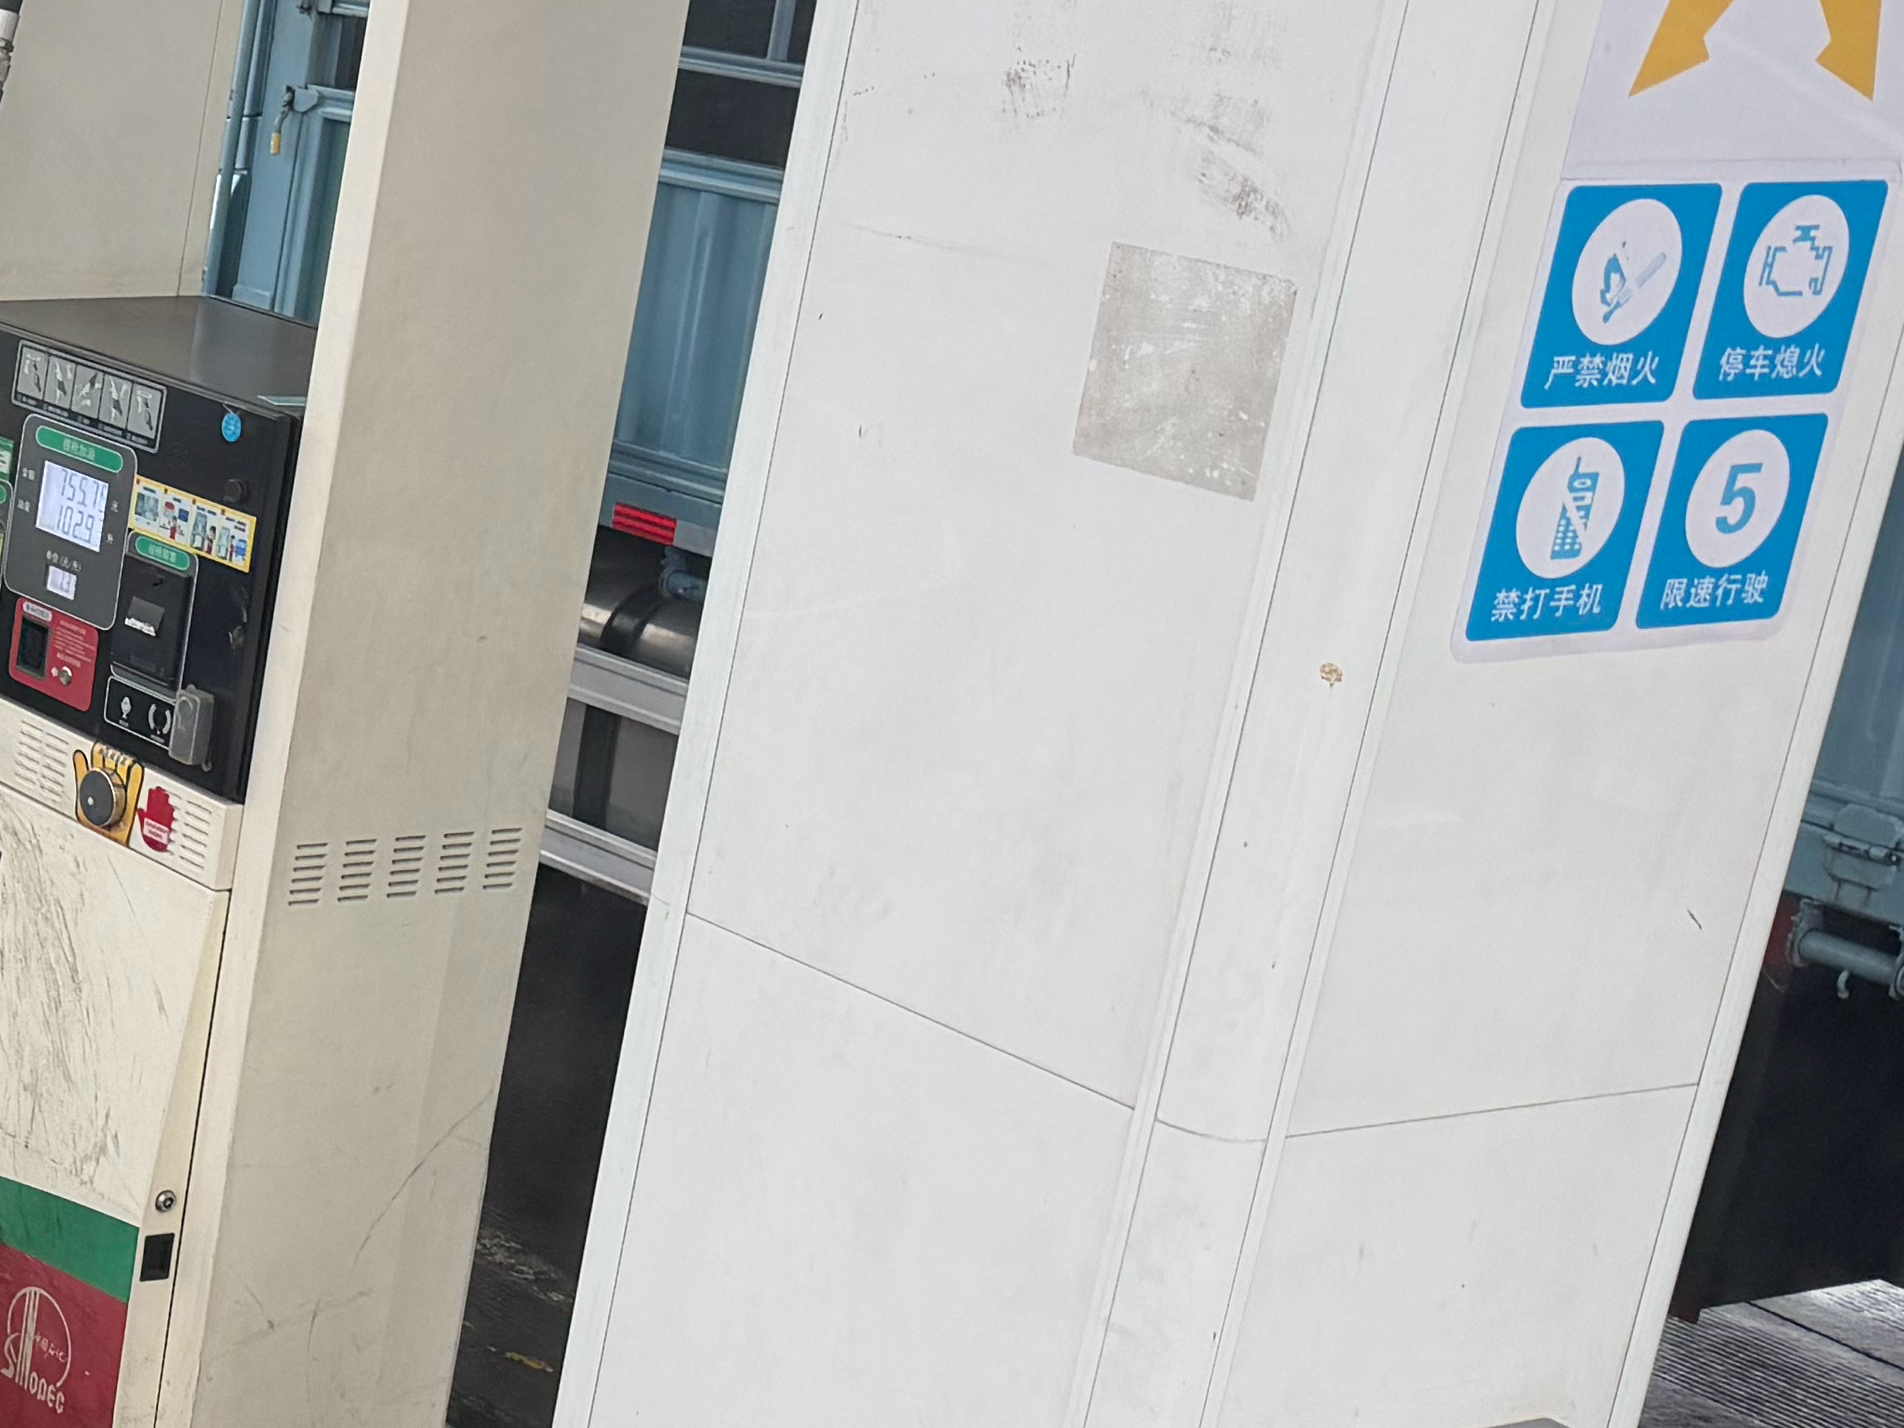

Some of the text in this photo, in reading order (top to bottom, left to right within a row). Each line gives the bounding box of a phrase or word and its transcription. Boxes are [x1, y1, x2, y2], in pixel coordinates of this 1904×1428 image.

[1544, 351, 1660, 390] 严禁烟火
[1718, 343, 1826, 382] 停车熄火
[1715, 463, 1764, 535] 5
[1491, 582, 1605, 623] 禁打手机
[1659, 570, 1770, 610] 限速行驶
